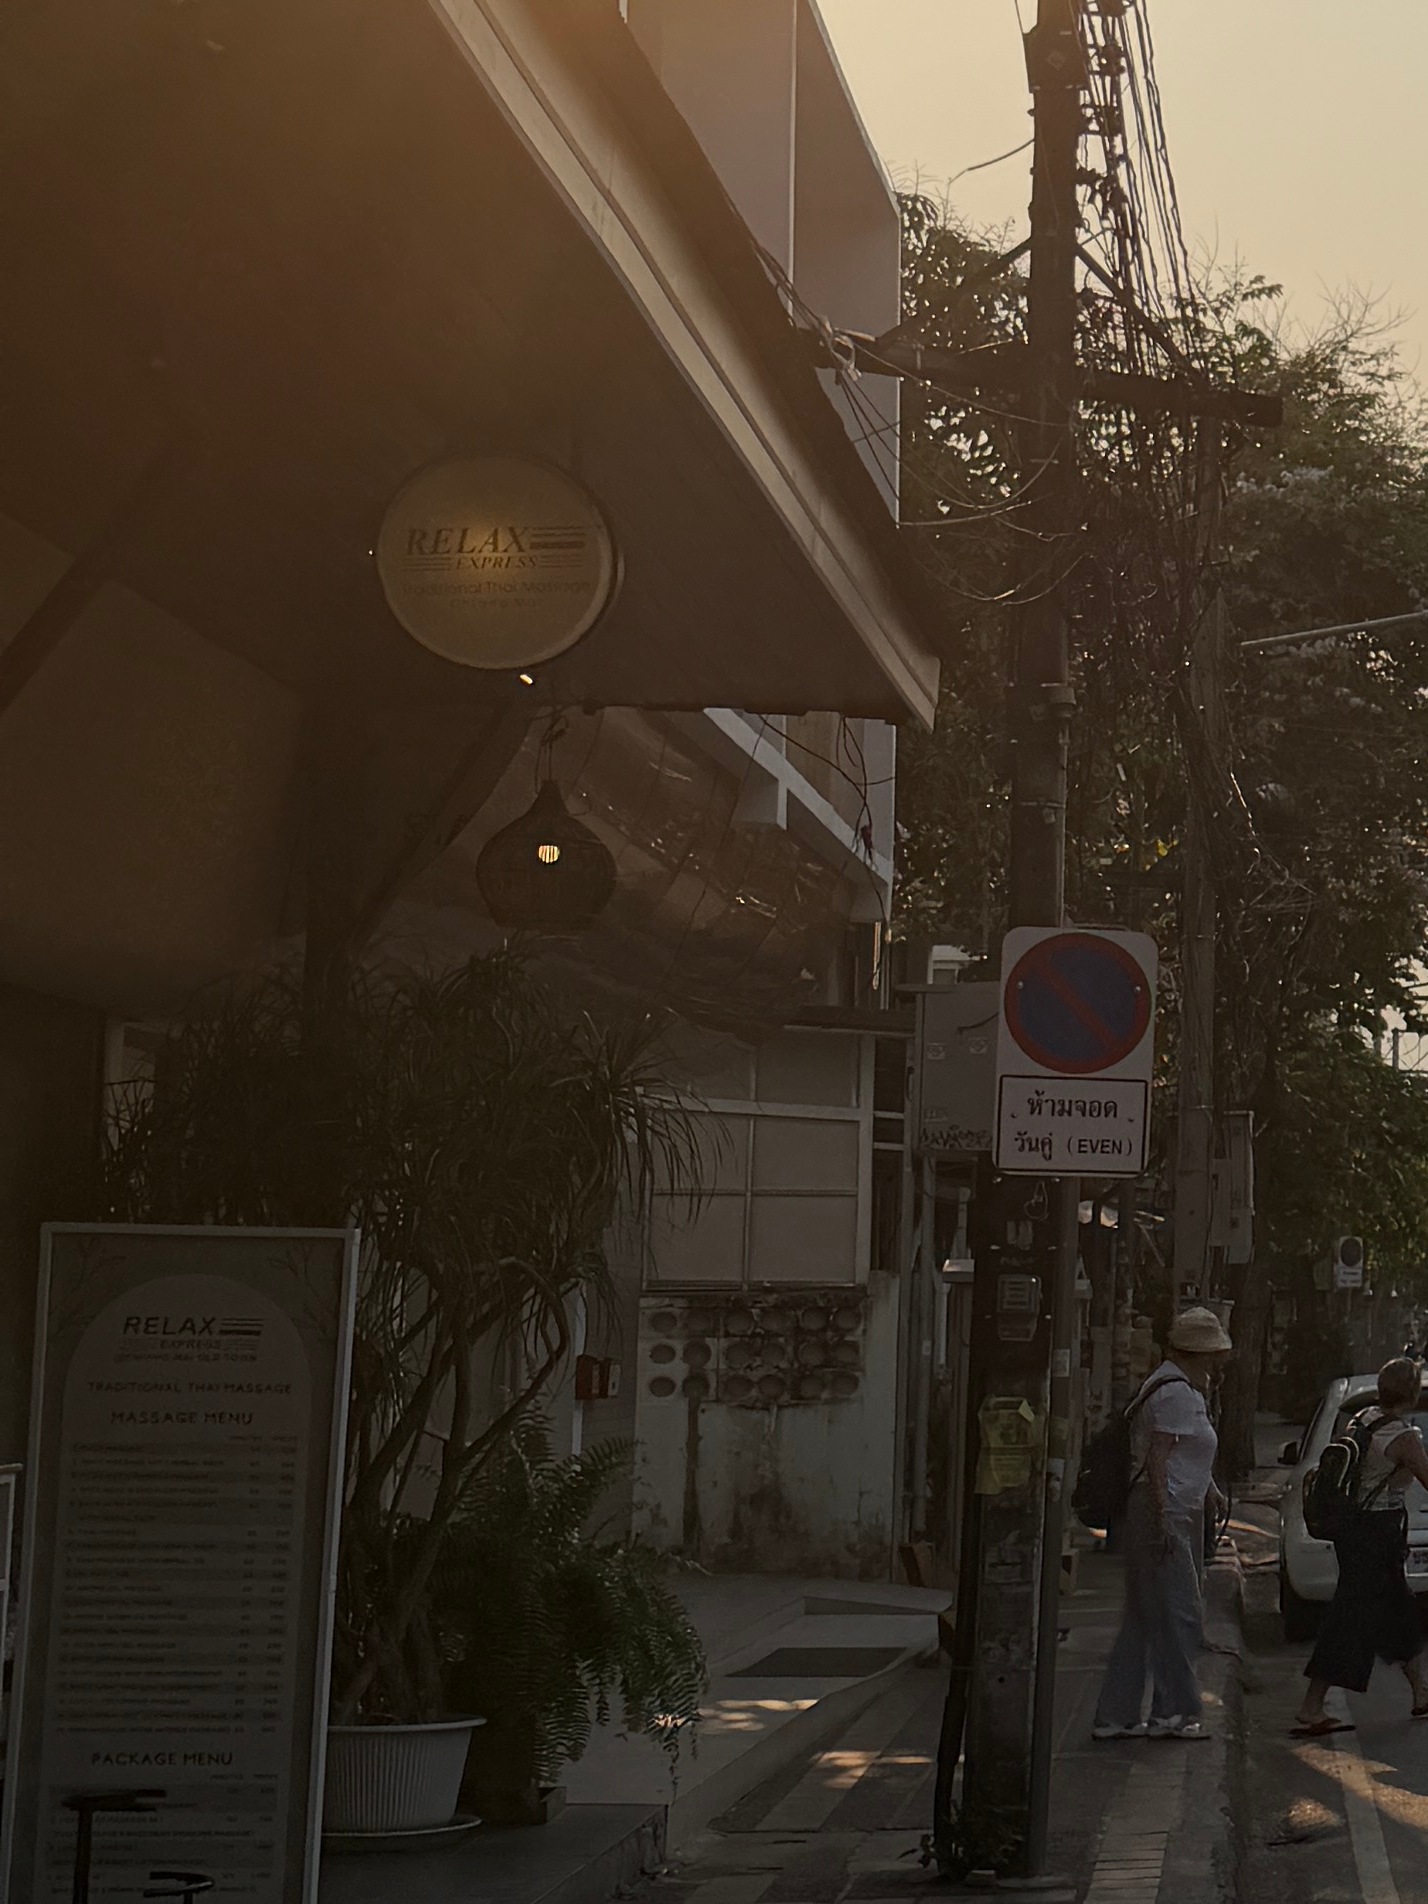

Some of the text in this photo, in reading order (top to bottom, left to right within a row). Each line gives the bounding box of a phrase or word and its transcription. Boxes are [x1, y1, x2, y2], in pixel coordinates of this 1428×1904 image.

[406, 526, 530, 556] RELAX
[455, 555, 538, 570] EXPRESS
[1027, 1089, 1118, 1119] ห้ามจอด
[1013, 1131, 1053, 1161] วันคู่
[123, 1315, 216, 1336] RELAX
[87, 1381, 293, 1394] TRADITIONAL THAI MASSAGE
[110, 1410, 254, 1425] MASSAGE MENU
[91, 1751, 233, 1766] PACKAGE MENU
